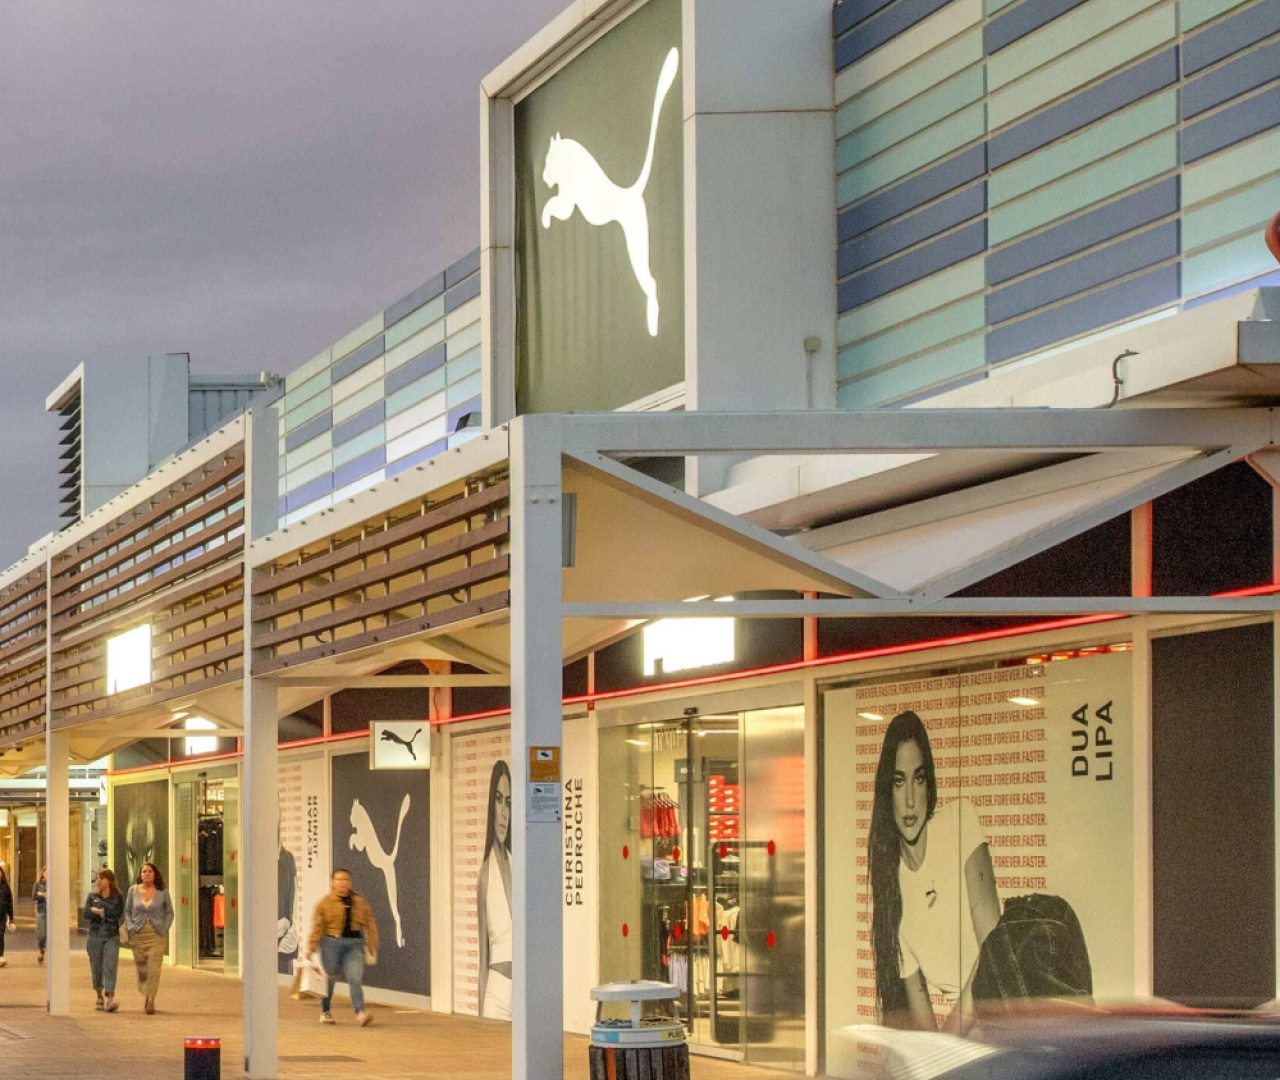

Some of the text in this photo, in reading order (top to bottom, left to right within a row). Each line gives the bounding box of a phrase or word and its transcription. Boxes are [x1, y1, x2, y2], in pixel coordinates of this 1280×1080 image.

[1071, 703, 1089, 777] DUA
[1095, 700, 1113, 782] LIPA
[565, 778, 573, 906] CHRISTINA
[575, 778, 584, 906] PEDROCHE
